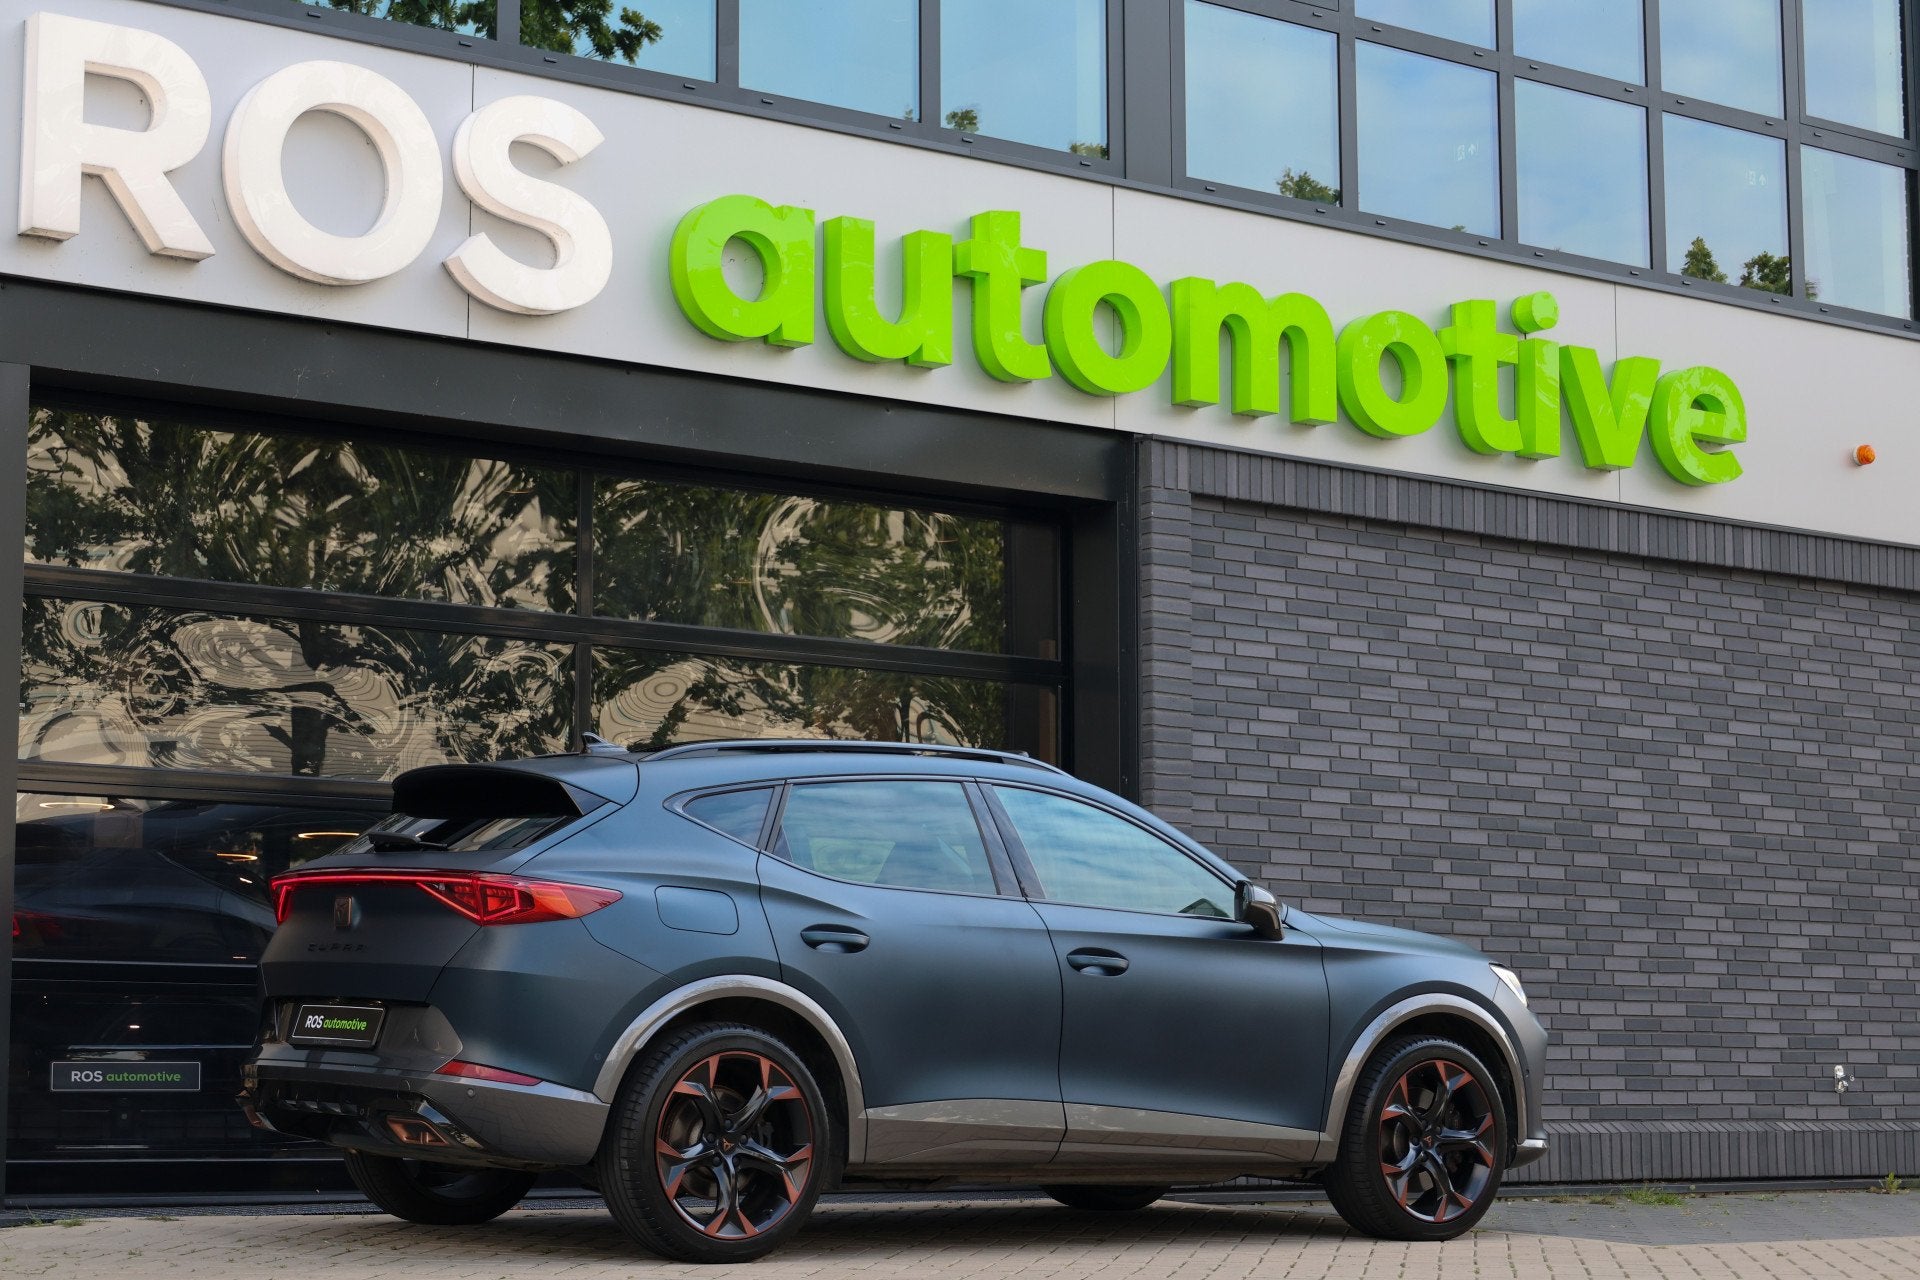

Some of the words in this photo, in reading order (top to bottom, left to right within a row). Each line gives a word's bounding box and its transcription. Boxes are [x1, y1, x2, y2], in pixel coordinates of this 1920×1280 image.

[18, 11, 613, 315] ROS
[669, 194, 1748, 486] automotive
[305, 1015, 324, 1029] ROS
[324, 1018, 368, 1031] automotive
[71, 1070, 103, 1083] ROS
[106, 1071, 181, 1083] automotive
